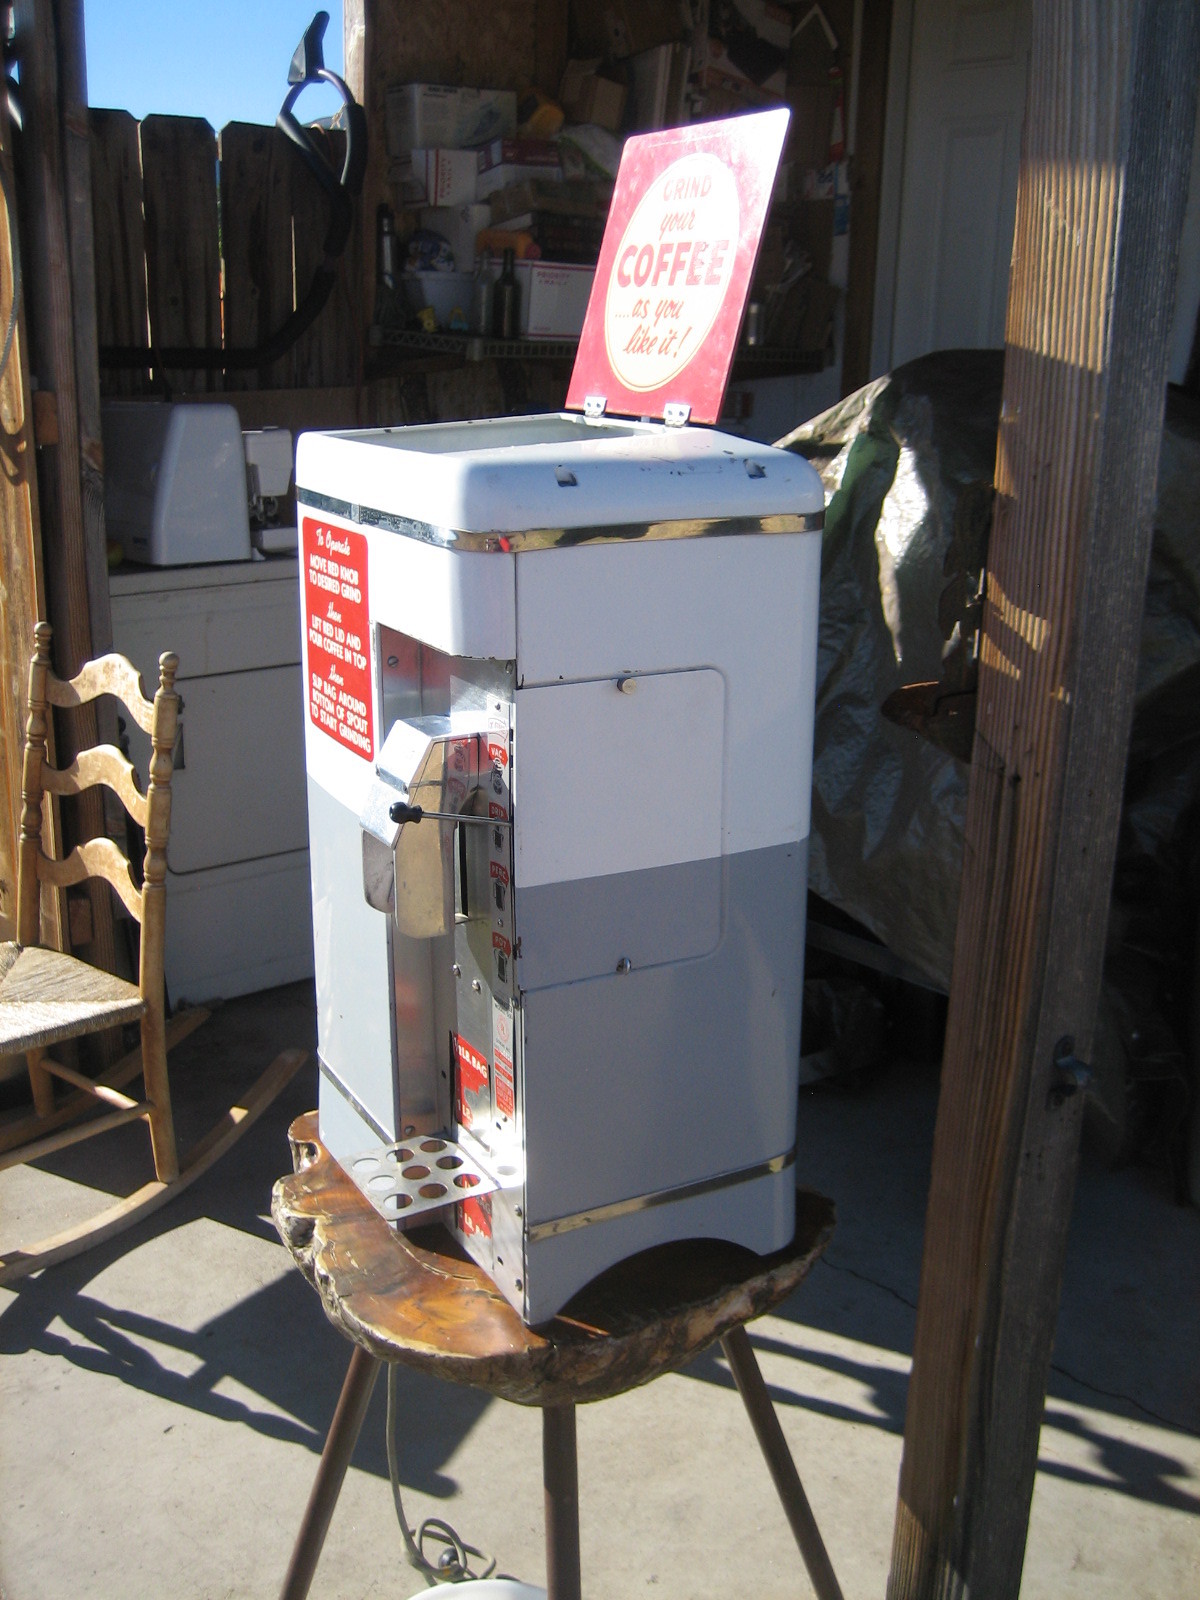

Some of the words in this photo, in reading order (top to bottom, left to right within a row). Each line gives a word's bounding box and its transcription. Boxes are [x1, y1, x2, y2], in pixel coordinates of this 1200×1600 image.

[663, 175, 712, 202] GRIND
[660, 208, 695, 240] your
[617, 240, 729, 288] COFFEE
[654, 299, 683, 326] you
[623, 325, 657, 355] like
[658, 326, 692, 359] it!
[316, 528, 324, 546] To
[326, 530, 350, 556] Operate
[309, 568, 317, 585] TO
[318, 572, 340, 594] DESIRED
[341, 583, 362, 604] GRIND
[310, 553, 327, 574] MOVE
[328, 560, 339, 577] RED
[340, 564, 359, 585] KNOB
[309, 628, 322, 648] POUR
[324, 637, 344, 660] COFFEE
[344, 647, 352, 664] IN
[353, 652, 367, 671] TOP
[312, 614, 322, 630] LIFT
[323, 620, 334, 638] RED
[335, 626, 345, 644] LID
[346, 632, 361, 651] AND
[312, 672, 322, 690] SLIP
[323, 680, 336, 700] BAG
[339, 690, 366, 717] AROUND
[312, 688, 335, 715] BOTTOM
[336, 704, 344, 720] OF
[346, 712, 368, 734] SPOUT
[310, 702, 319, 718] TO
[320, 709, 338, 732] START
[339, 722, 372, 754] GRINDING
[494, 936, 507, 949] POT
[472, 1055, 488, 1079] BAG
